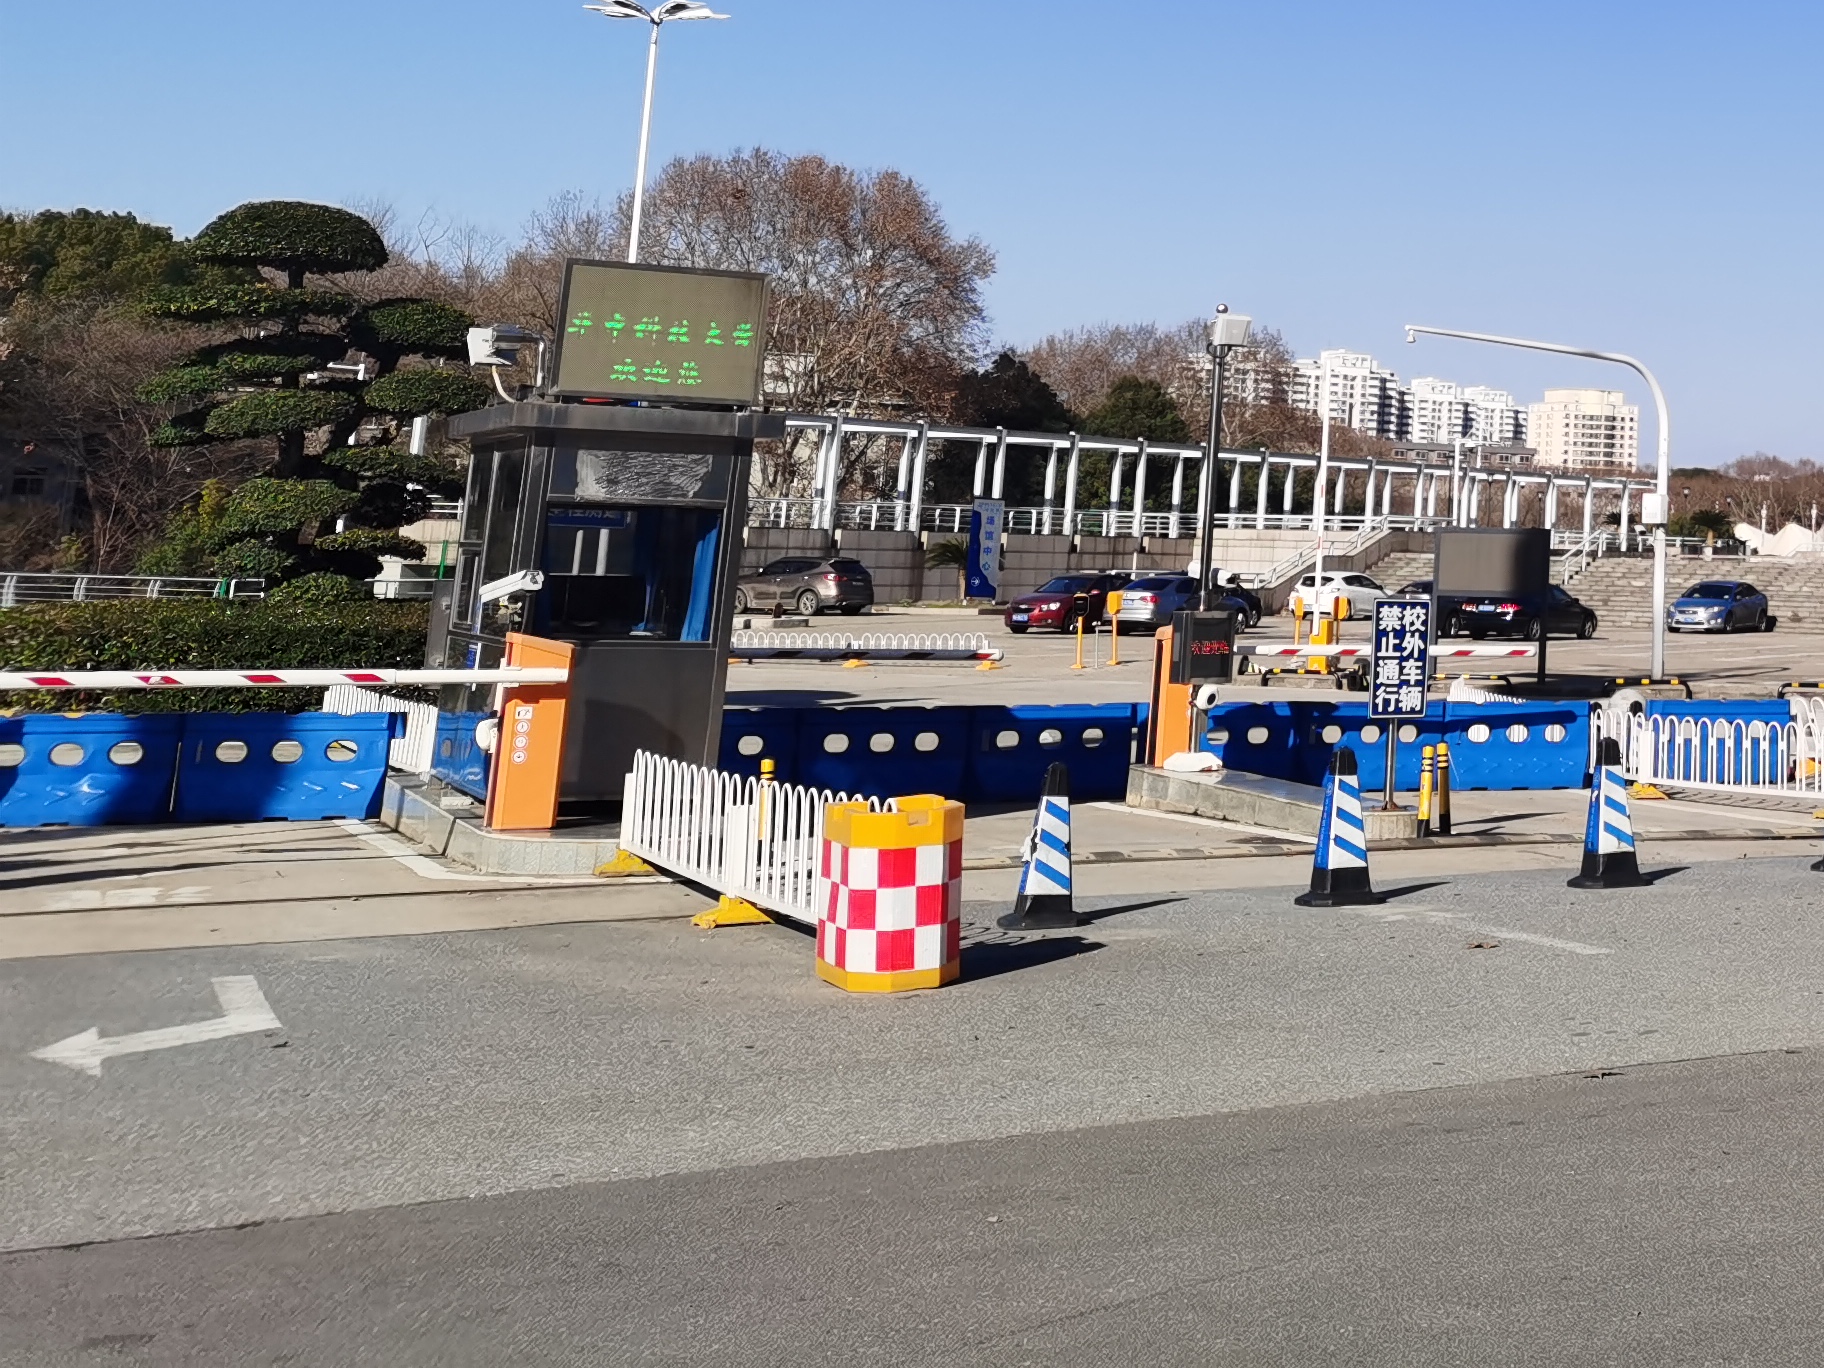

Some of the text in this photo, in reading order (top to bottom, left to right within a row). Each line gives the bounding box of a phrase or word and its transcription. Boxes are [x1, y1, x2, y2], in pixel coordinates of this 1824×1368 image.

[1190, 640, 1230, 655] 欢迎光临
[1375, 605, 1403, 713] 禁止通行
[1399, 605, 1427, 712] 校外车辆
